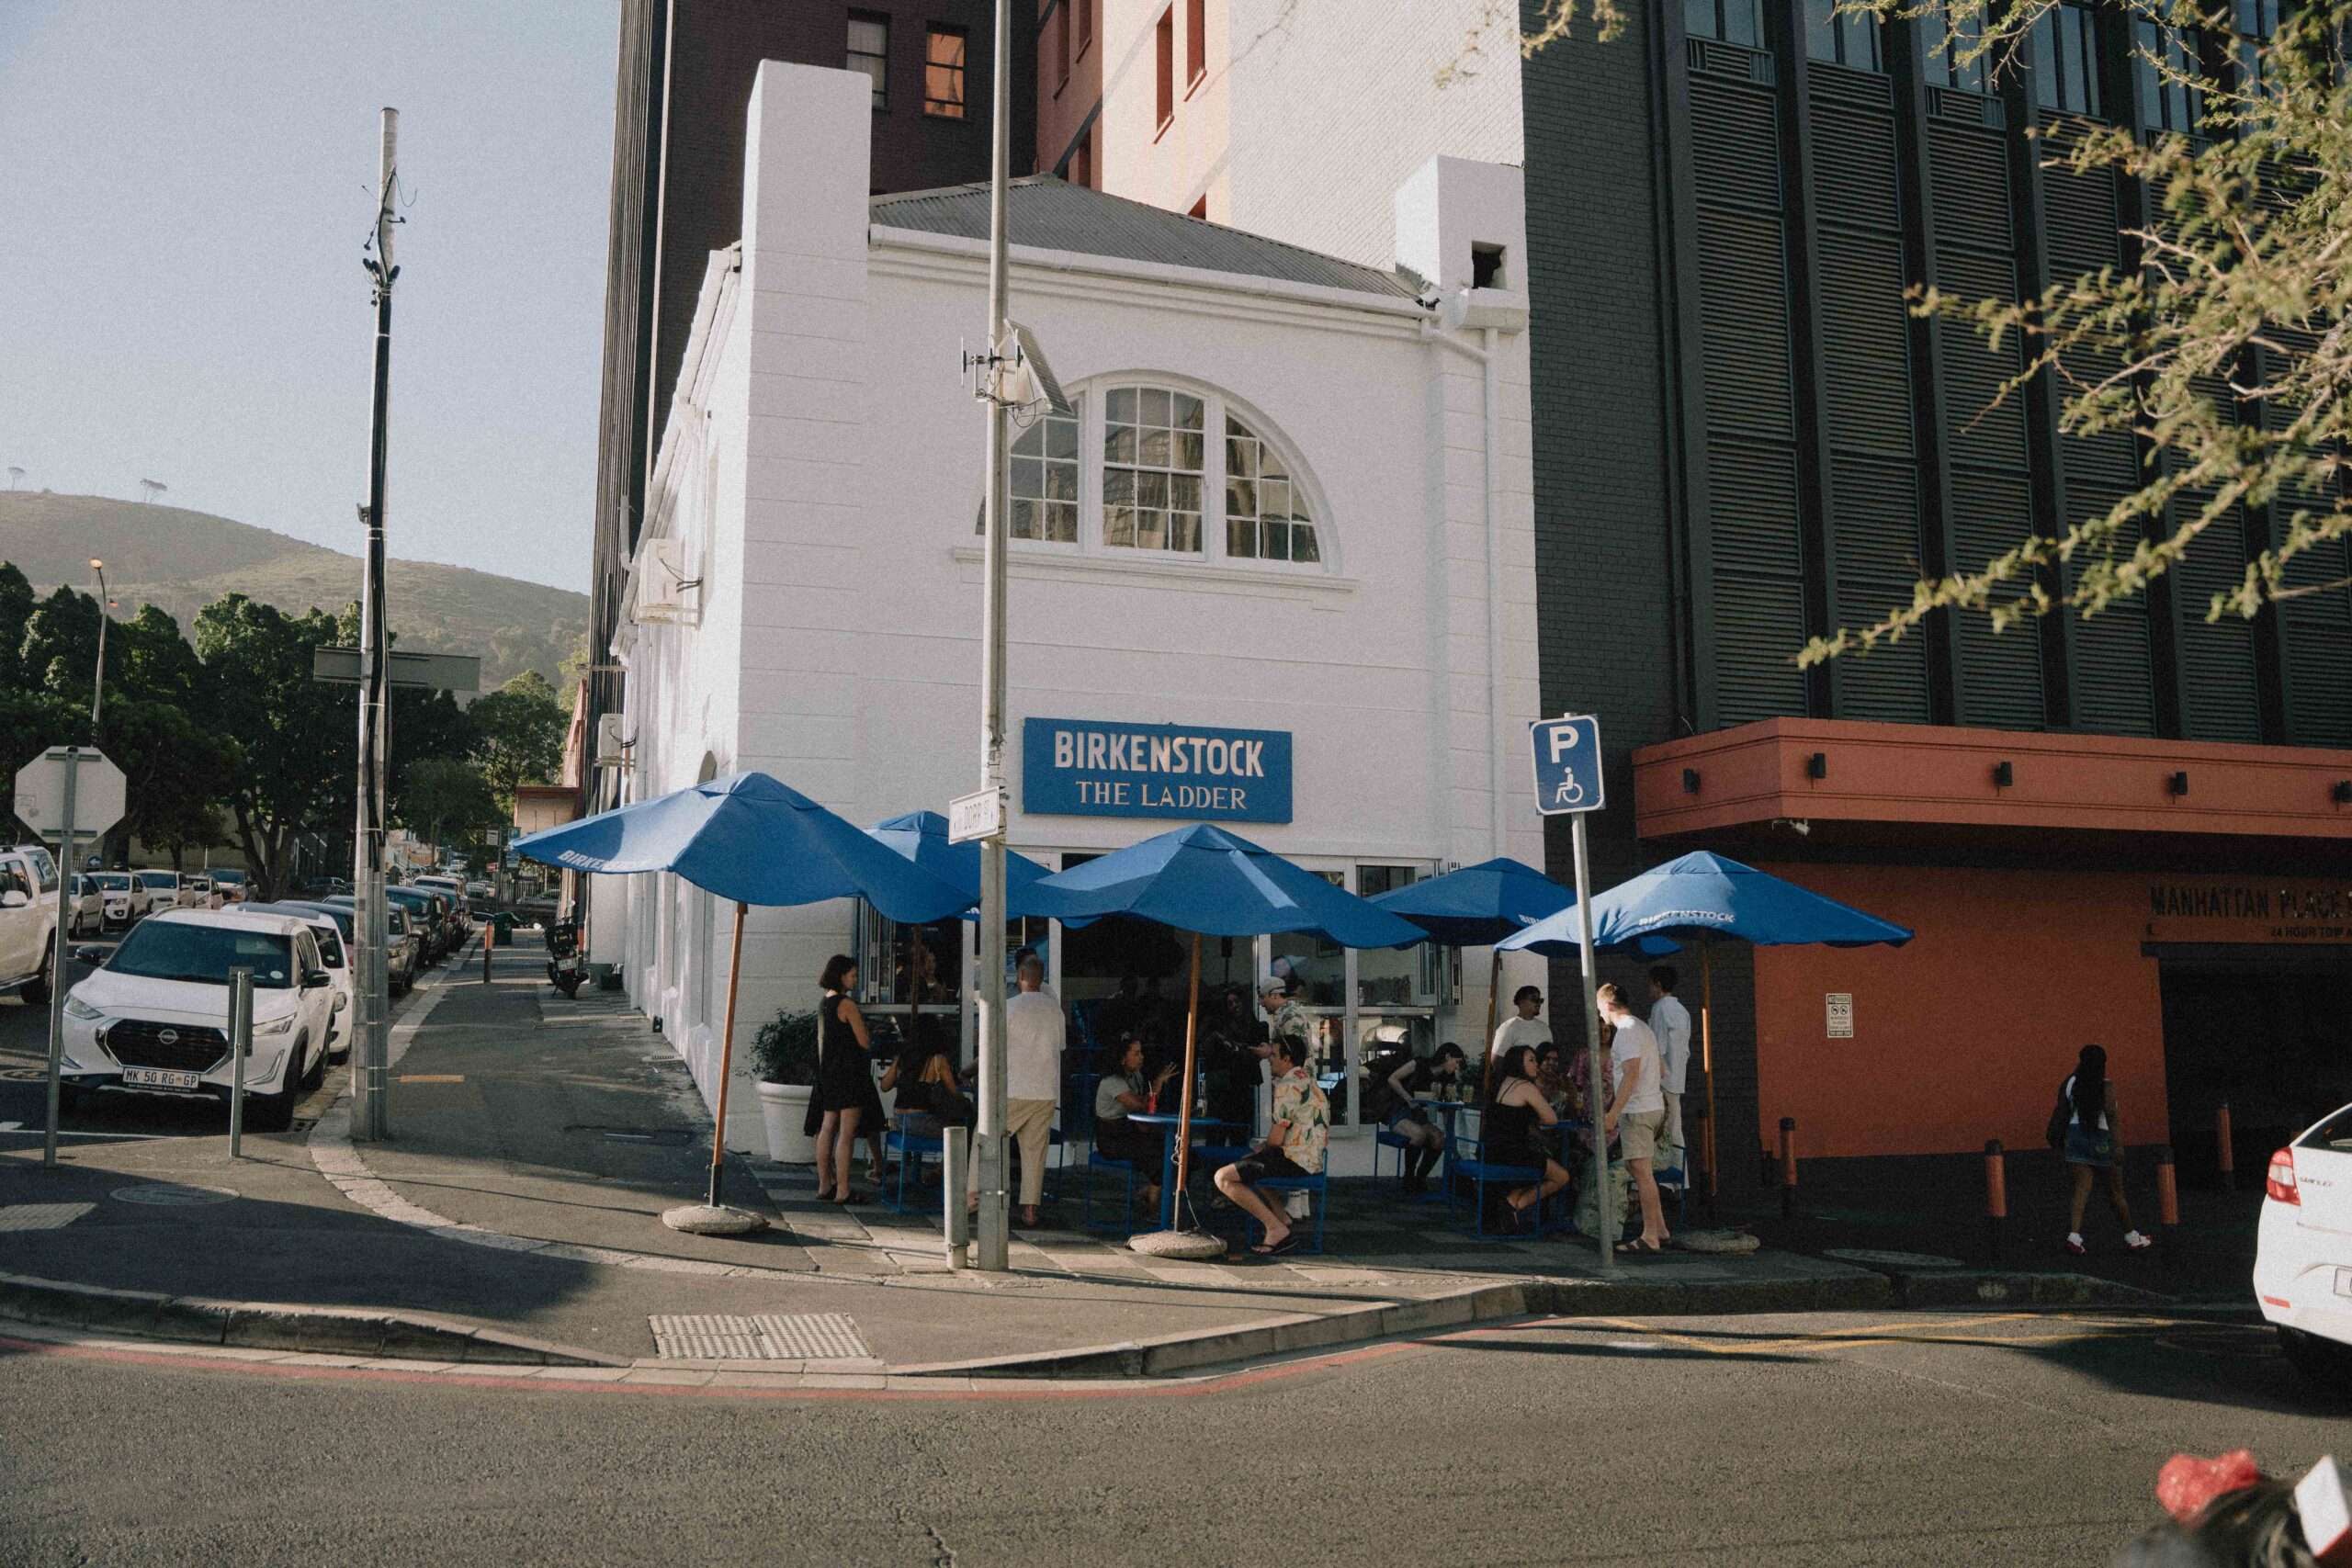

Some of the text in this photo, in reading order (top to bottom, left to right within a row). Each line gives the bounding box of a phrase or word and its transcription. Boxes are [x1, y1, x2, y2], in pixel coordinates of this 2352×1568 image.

[1055, 730, 1264, 777] BIRKENSTOCK
[1549, 726, 1579, 763] P
[1076, 781, 1248, 810] THE LADDER
[964, 802, 981, 830] DORP
[2150, 887, 2269, 918] MANHATTAN
[2279, 889, 2342, 919] PLACE
[1638, 910, 1736, 926] BIRKENSTOCK
[2284, 927, 2315, 938] HOUR
[2318, 927, 2343, 938] TOW
[126, 1069, 197, 1087] MK 50 RG GP
